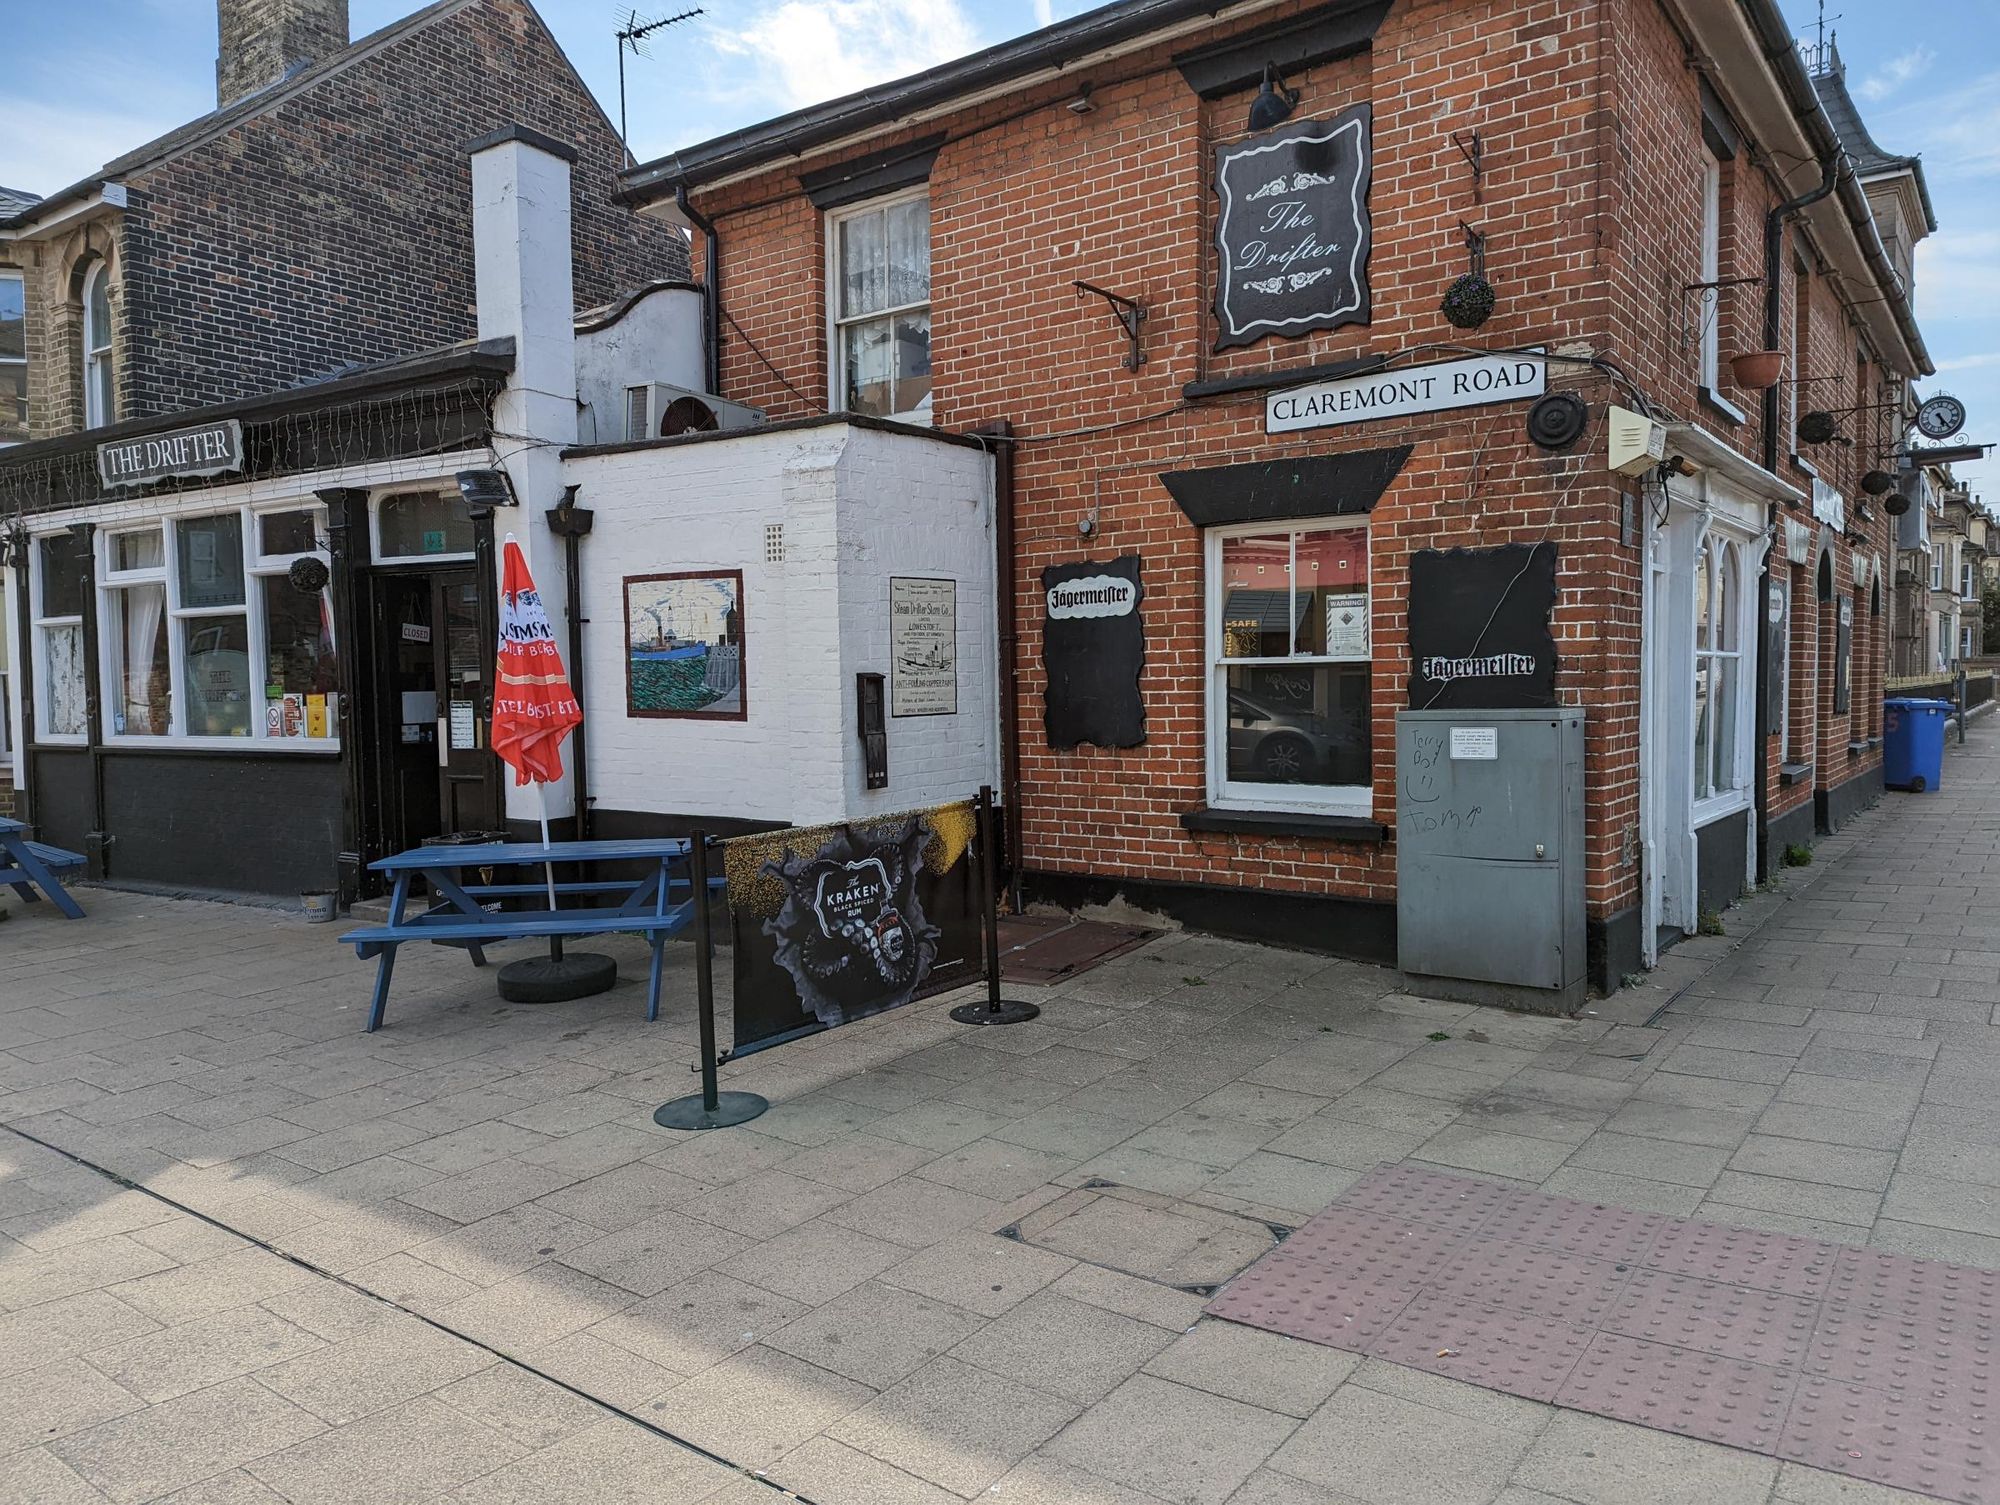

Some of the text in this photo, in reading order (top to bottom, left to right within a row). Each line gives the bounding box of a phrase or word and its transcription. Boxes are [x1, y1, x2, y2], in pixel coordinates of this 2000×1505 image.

[1260, 201, 1315, 232] The
[1234, 232, 1341, 272] Drifter
[1273, 362, 1536, 420] CLAREMONT ROAD
[106, 430, 230, 475] THE DRIFTER
[403, 626, 429, 640] CLOSED
[846, 875, 860, 889] The
[826, 884, 880, 906] KRAKEN
[834, 898, 874, 913] BLACK SPICED
[847, 908, 862, 918] RUM
